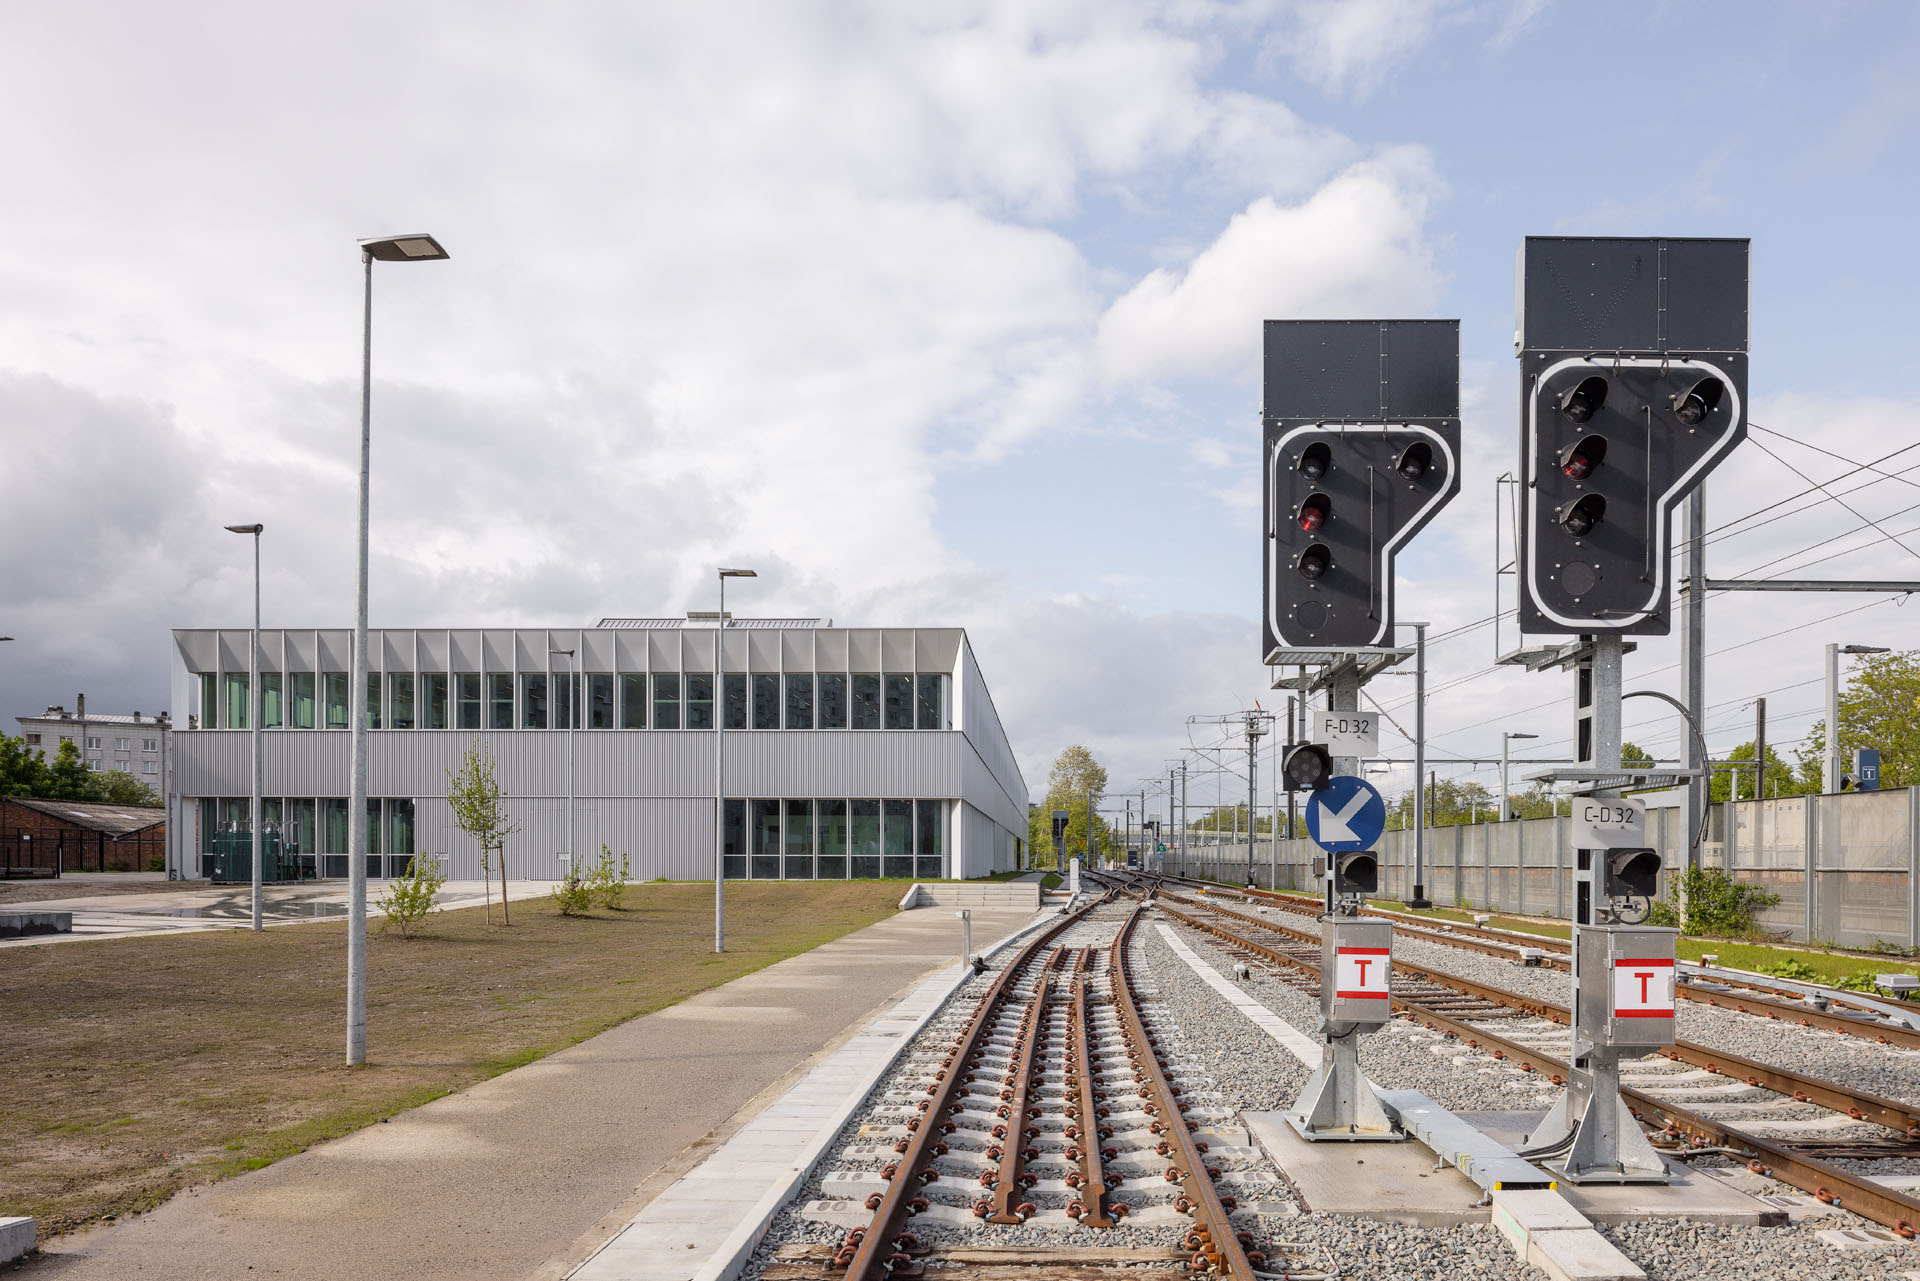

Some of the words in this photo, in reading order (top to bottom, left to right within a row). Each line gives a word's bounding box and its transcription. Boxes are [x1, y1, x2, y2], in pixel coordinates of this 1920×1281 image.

[1325, 719, 1369, 734] F-D.32
[1584, 806, 1634, 824] C-D.32
[1354, 959, 1372, 987] T
[1634, 972, 1654, 1003] T
